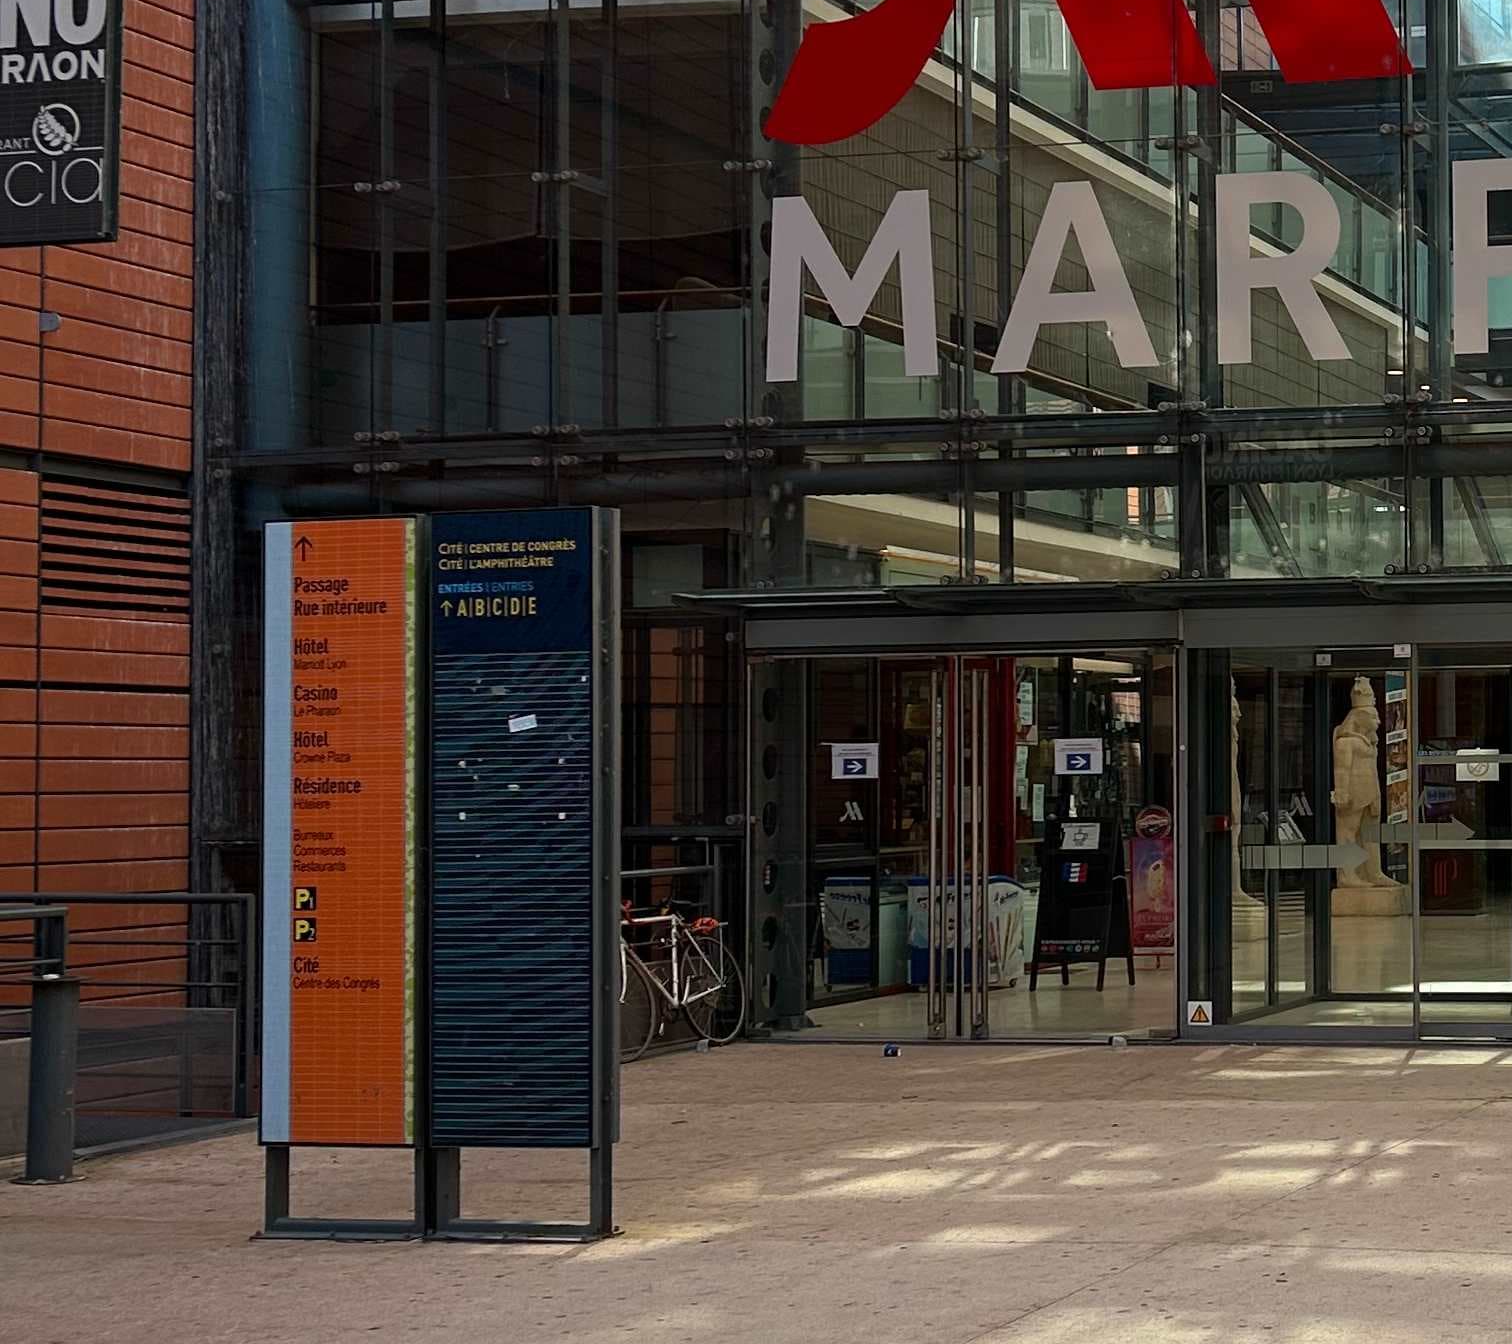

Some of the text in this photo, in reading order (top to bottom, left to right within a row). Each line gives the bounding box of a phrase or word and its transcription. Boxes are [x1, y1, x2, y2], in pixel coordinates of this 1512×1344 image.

[469, 542, 511, 554] CENTRE
[511, 541, 526, 552] DE
[527, 538, 576, 552] CONGRÈS
[294, 577, 349, 595] Passage
[438, 580, 534, 594] ENTRÉES ENTRIES
[294, 598, 387, 616] Rue intérieure
[294, 638, 329, 655] Hôtel
[294, 684, 338, 701] Casino
[294, 731, 329, 747] Hôtel
[294, 777, 362, 794] Résidence
[294, 845, 346, 856] Commerces
[294, 957, 320, 973] Cité
